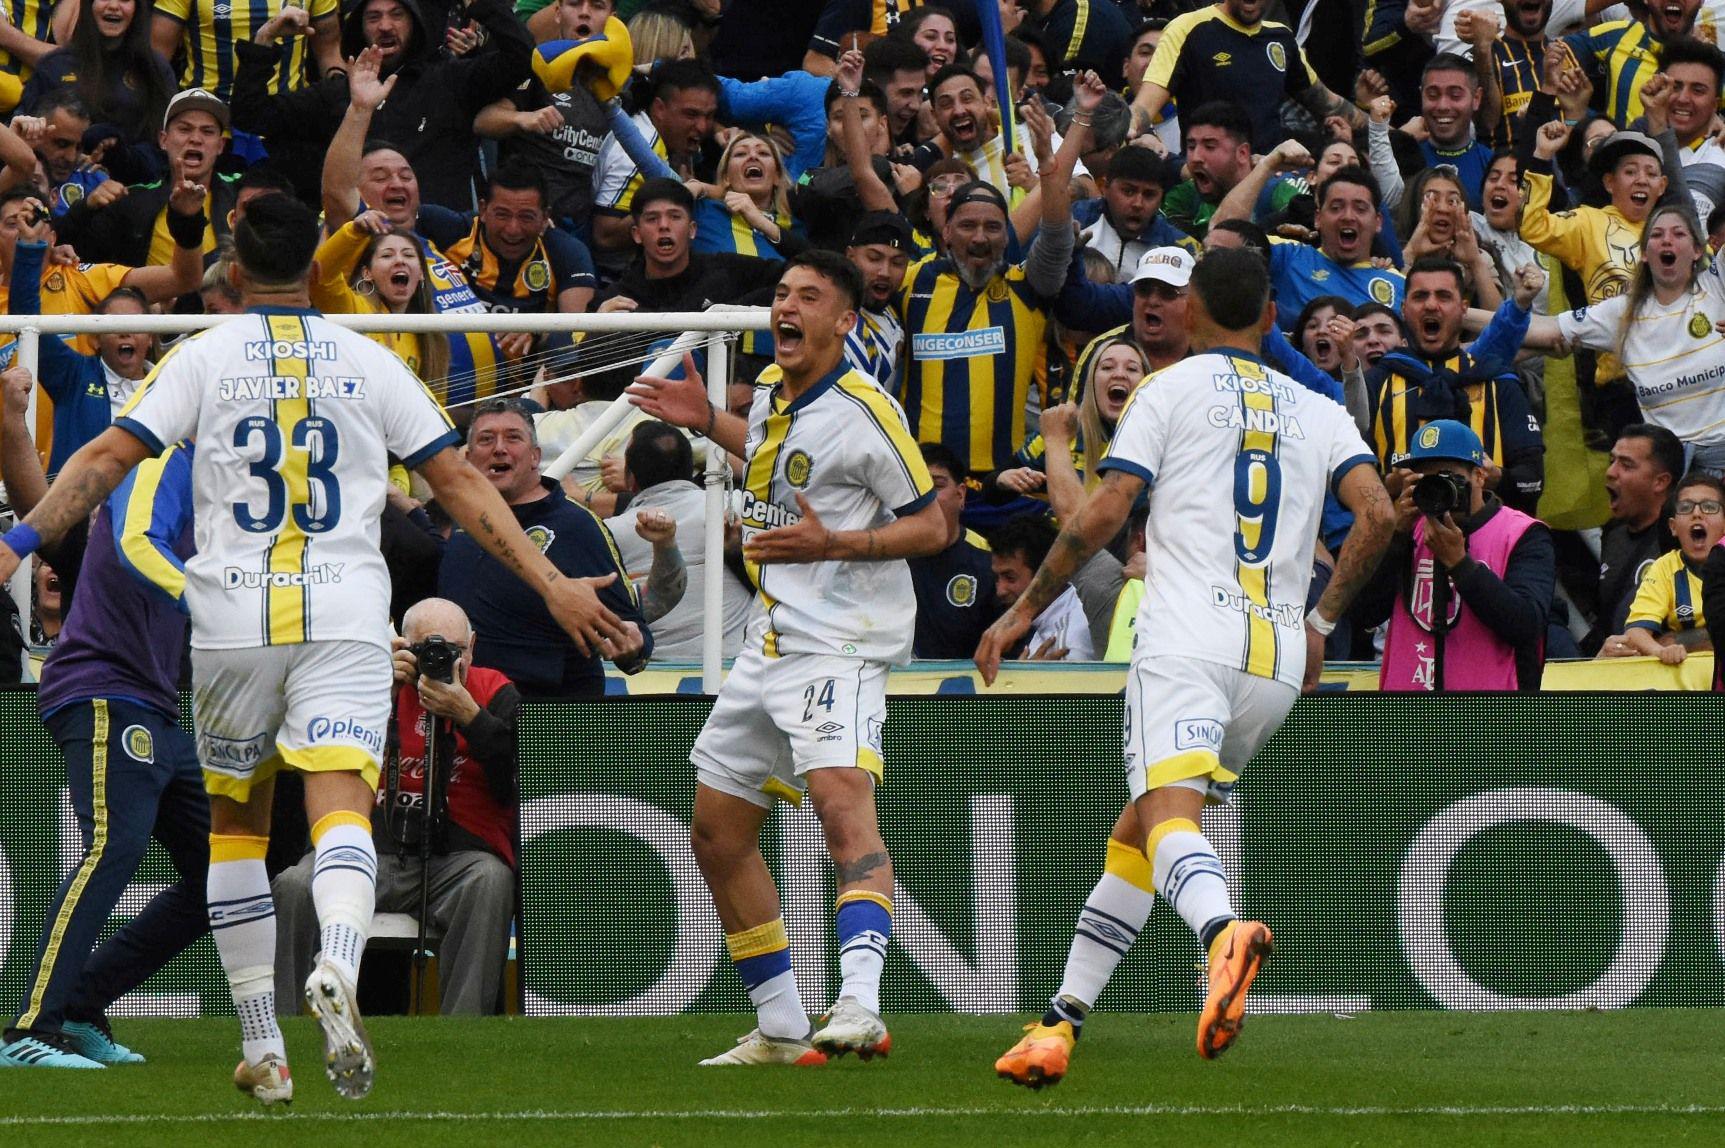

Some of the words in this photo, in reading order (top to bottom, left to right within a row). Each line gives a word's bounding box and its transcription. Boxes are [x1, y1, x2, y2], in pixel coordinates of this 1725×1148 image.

[245, 340, 337, 361] KIOSHI
[219, 376, 301, 401] JAVIER
[305, 376, 365, 400] BAEZ
[1213, 374, 1296, 404] KIOSHI
[1638, 382, 1673, 397] Banco
[248, 420, 265, 428] RUS
[306, 420, 323, 428] RUS
[1207, 405, 1305, 440] CANDIA
[232, 415, 342, 534] 33
[741, 489, 804, 528] Cente
[1233, 449, 1282, 564] 9
[224, 563, 328, 590] Duracril
[802, 679, 835, 723] 24
[332, 718, 383, 751] plenit
[817, 734, 842, 742] umbro
